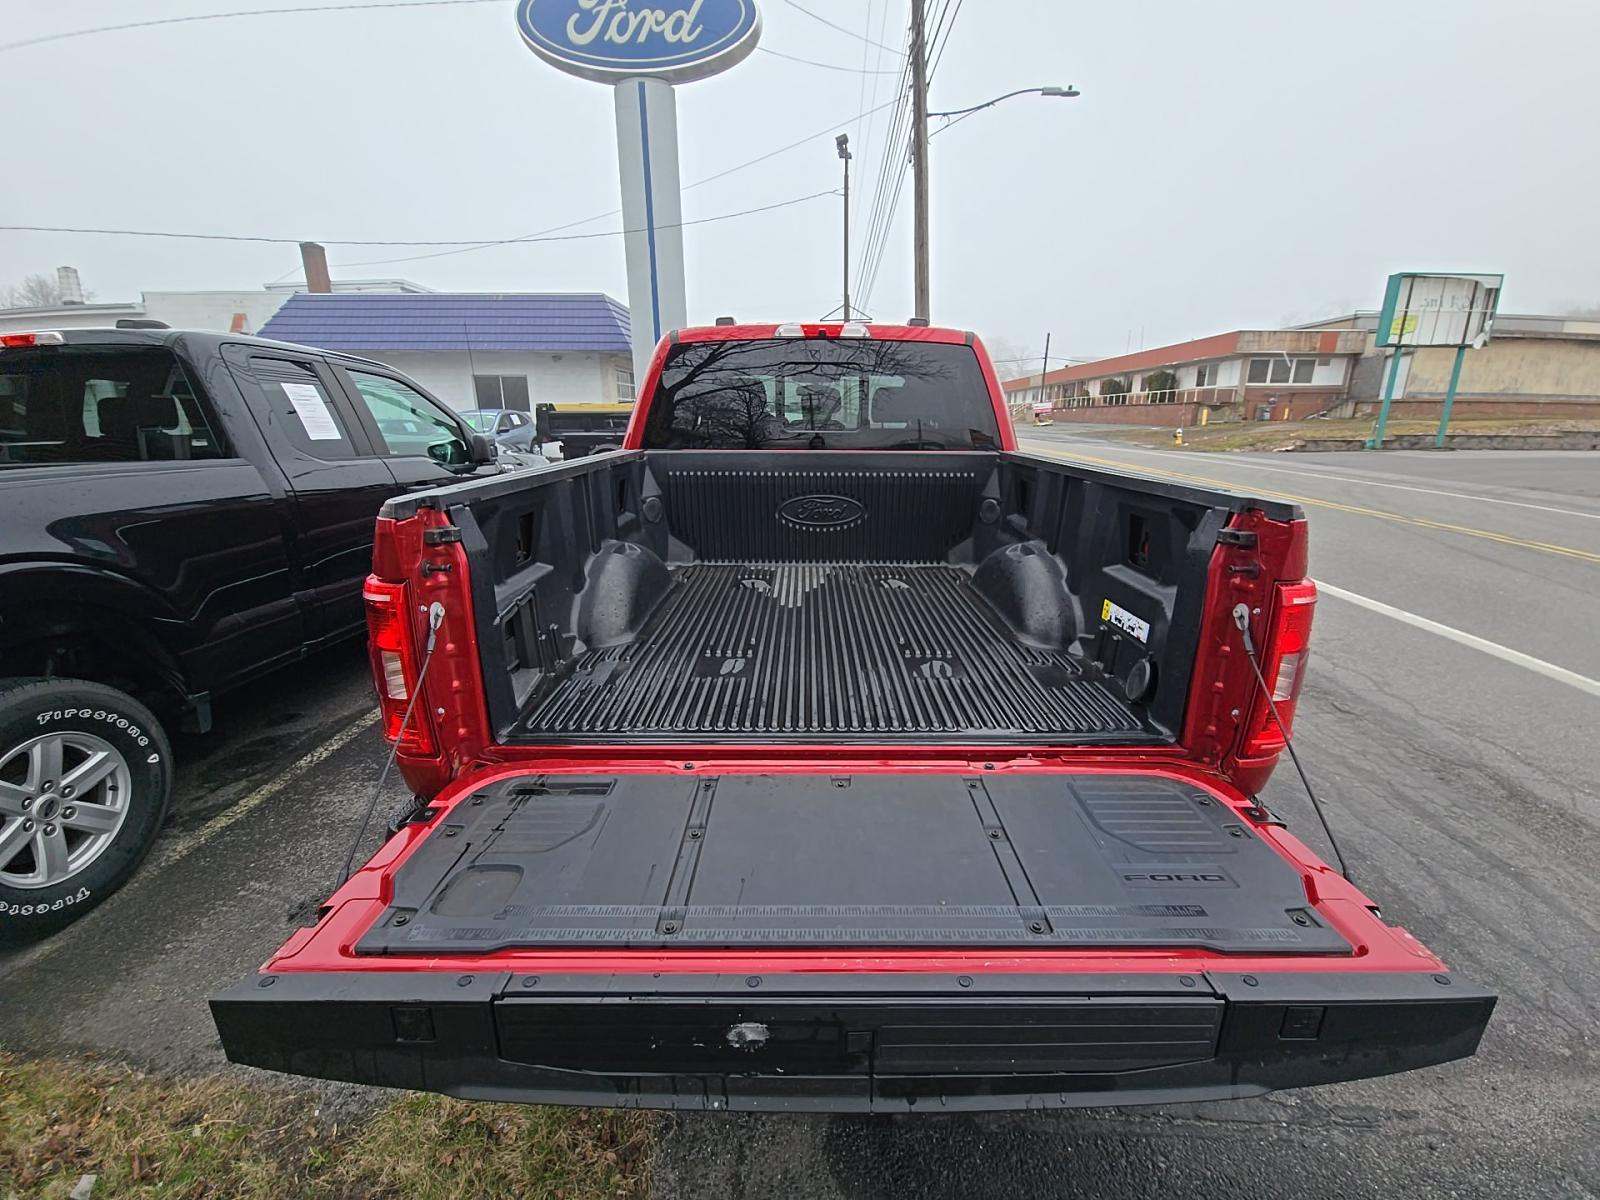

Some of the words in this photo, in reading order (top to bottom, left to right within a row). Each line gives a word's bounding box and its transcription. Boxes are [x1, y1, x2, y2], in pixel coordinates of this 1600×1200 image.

[566, 0, 703, 45] Ford
[37, 708, 150, 747] Firestone
[1123, 873, 1227, 883] FORD
